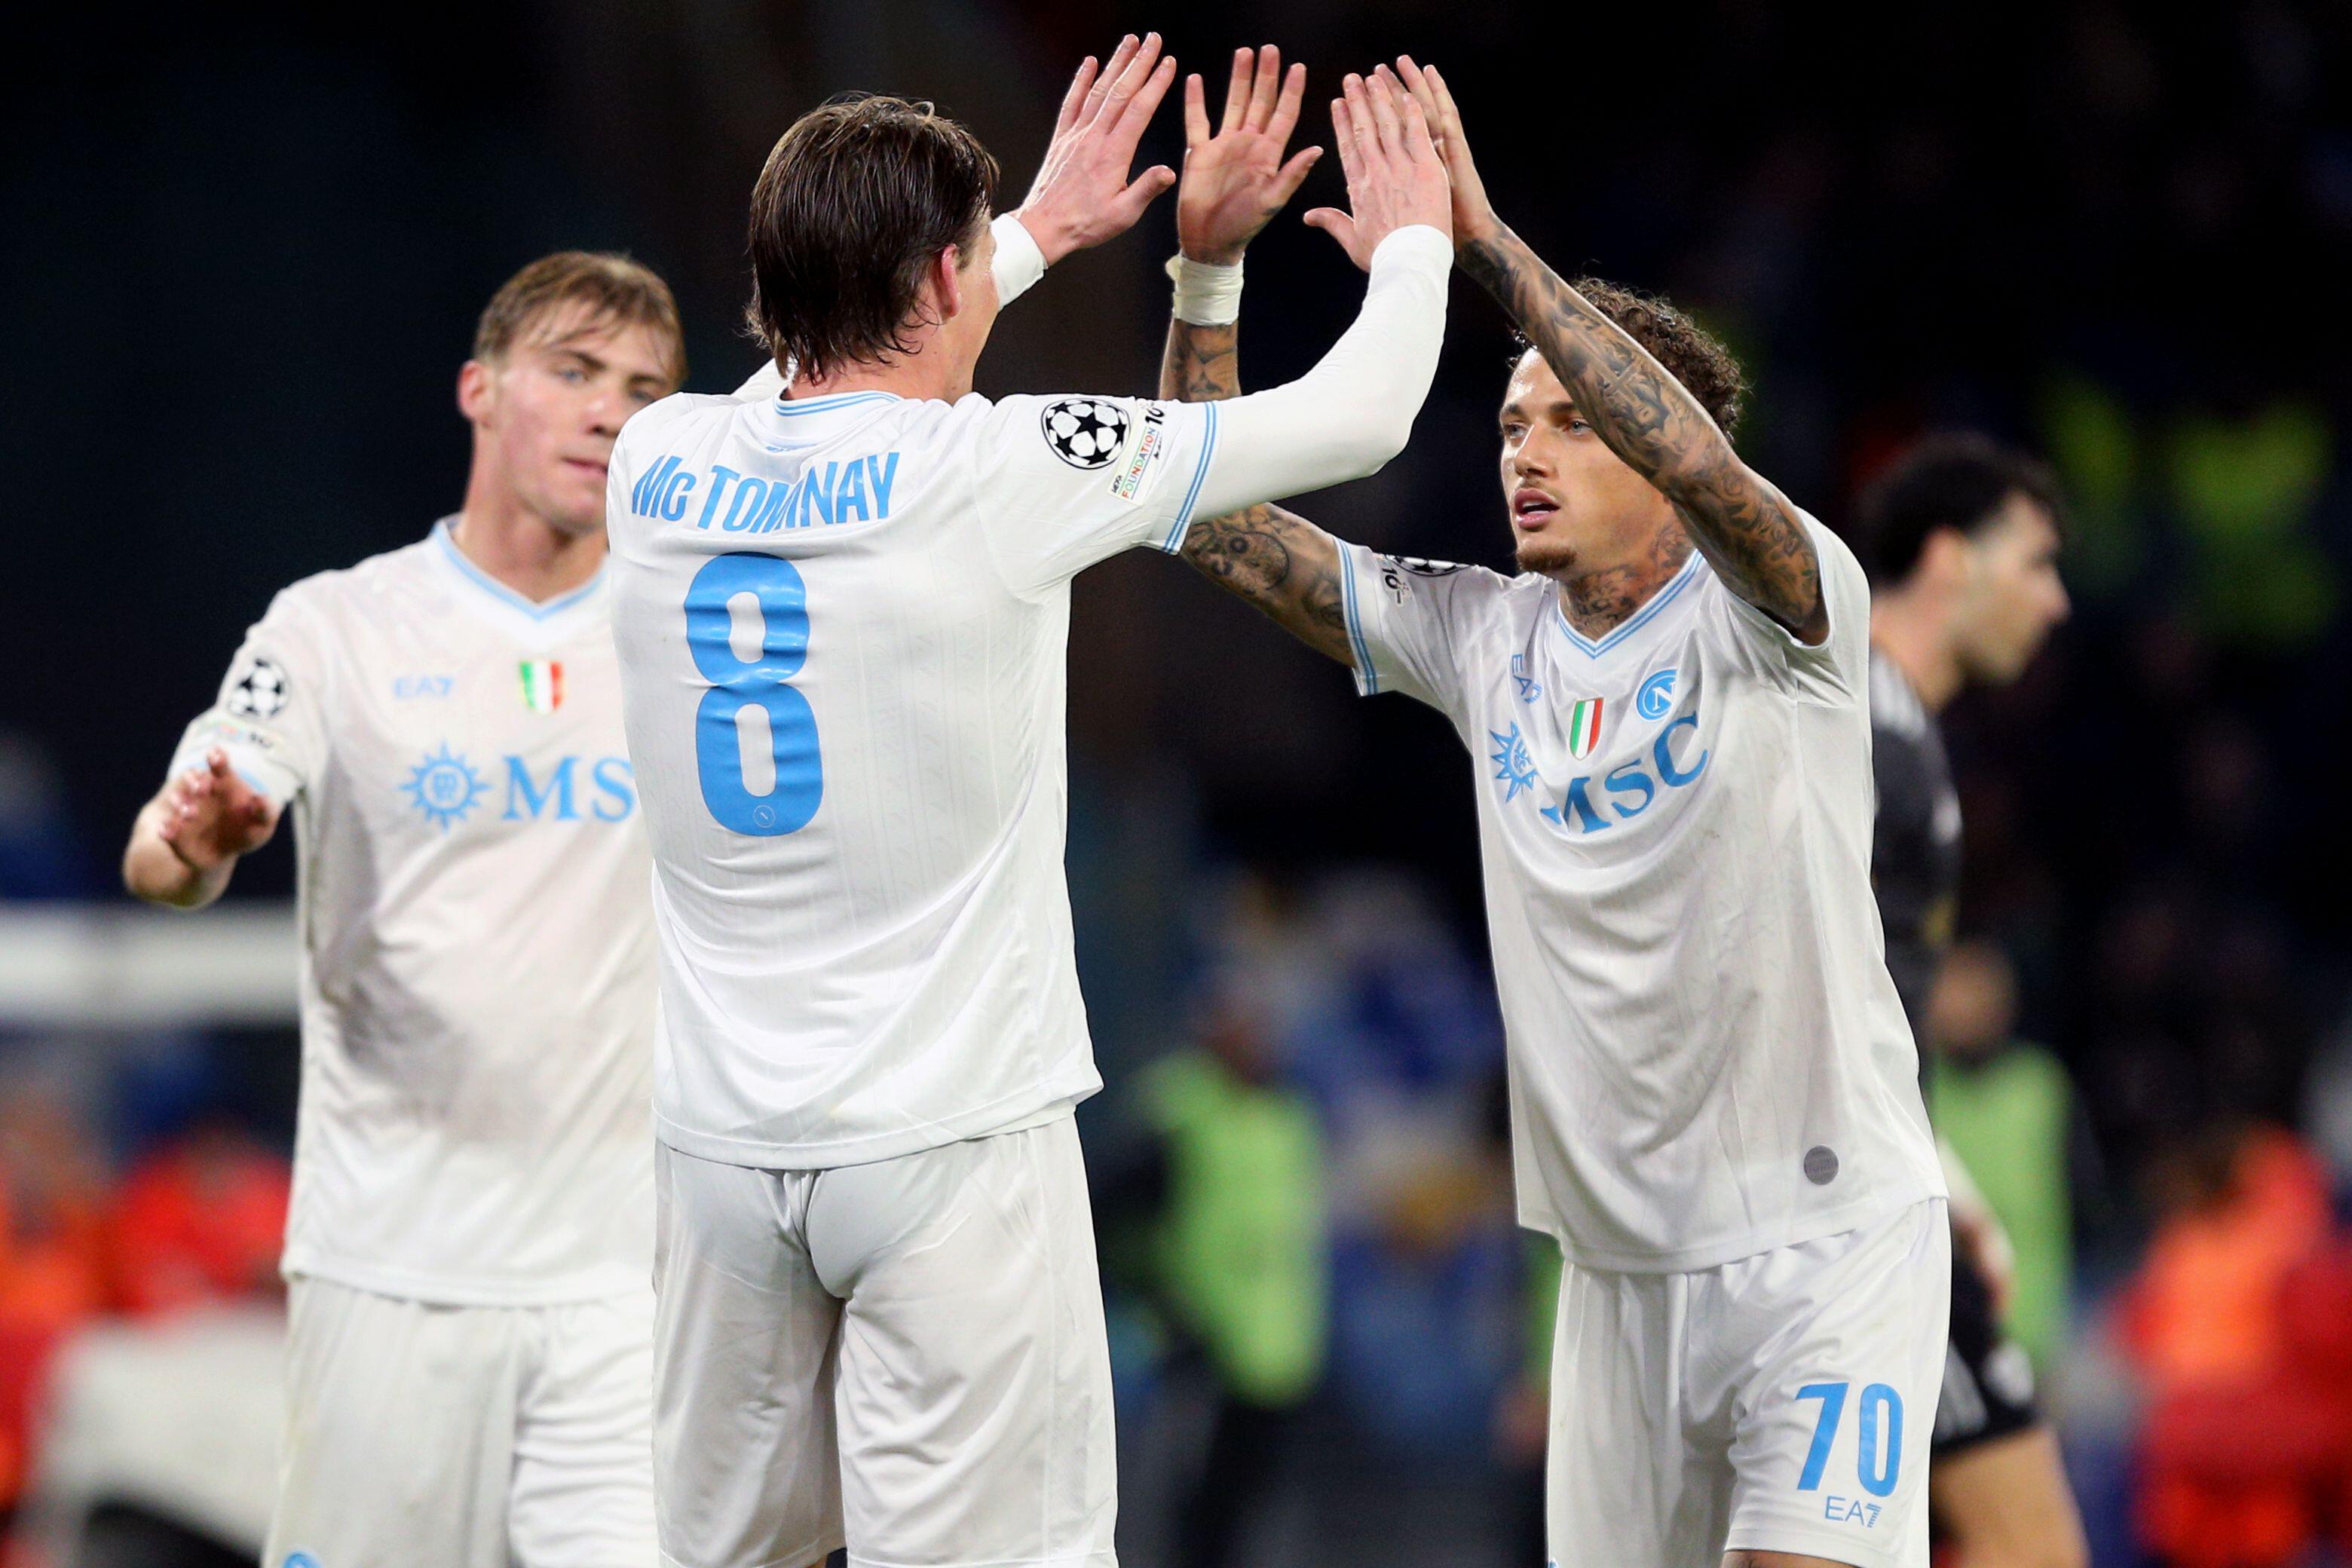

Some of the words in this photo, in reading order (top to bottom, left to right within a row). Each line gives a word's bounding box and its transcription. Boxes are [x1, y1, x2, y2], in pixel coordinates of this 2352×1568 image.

[1122, 427, 1156, 498] FOUNDATION
[683, 551, 824, 837] 8
[1795, 1383, 1904, 1497] 70
[1825, 1496, 1882, 1528] EA7
